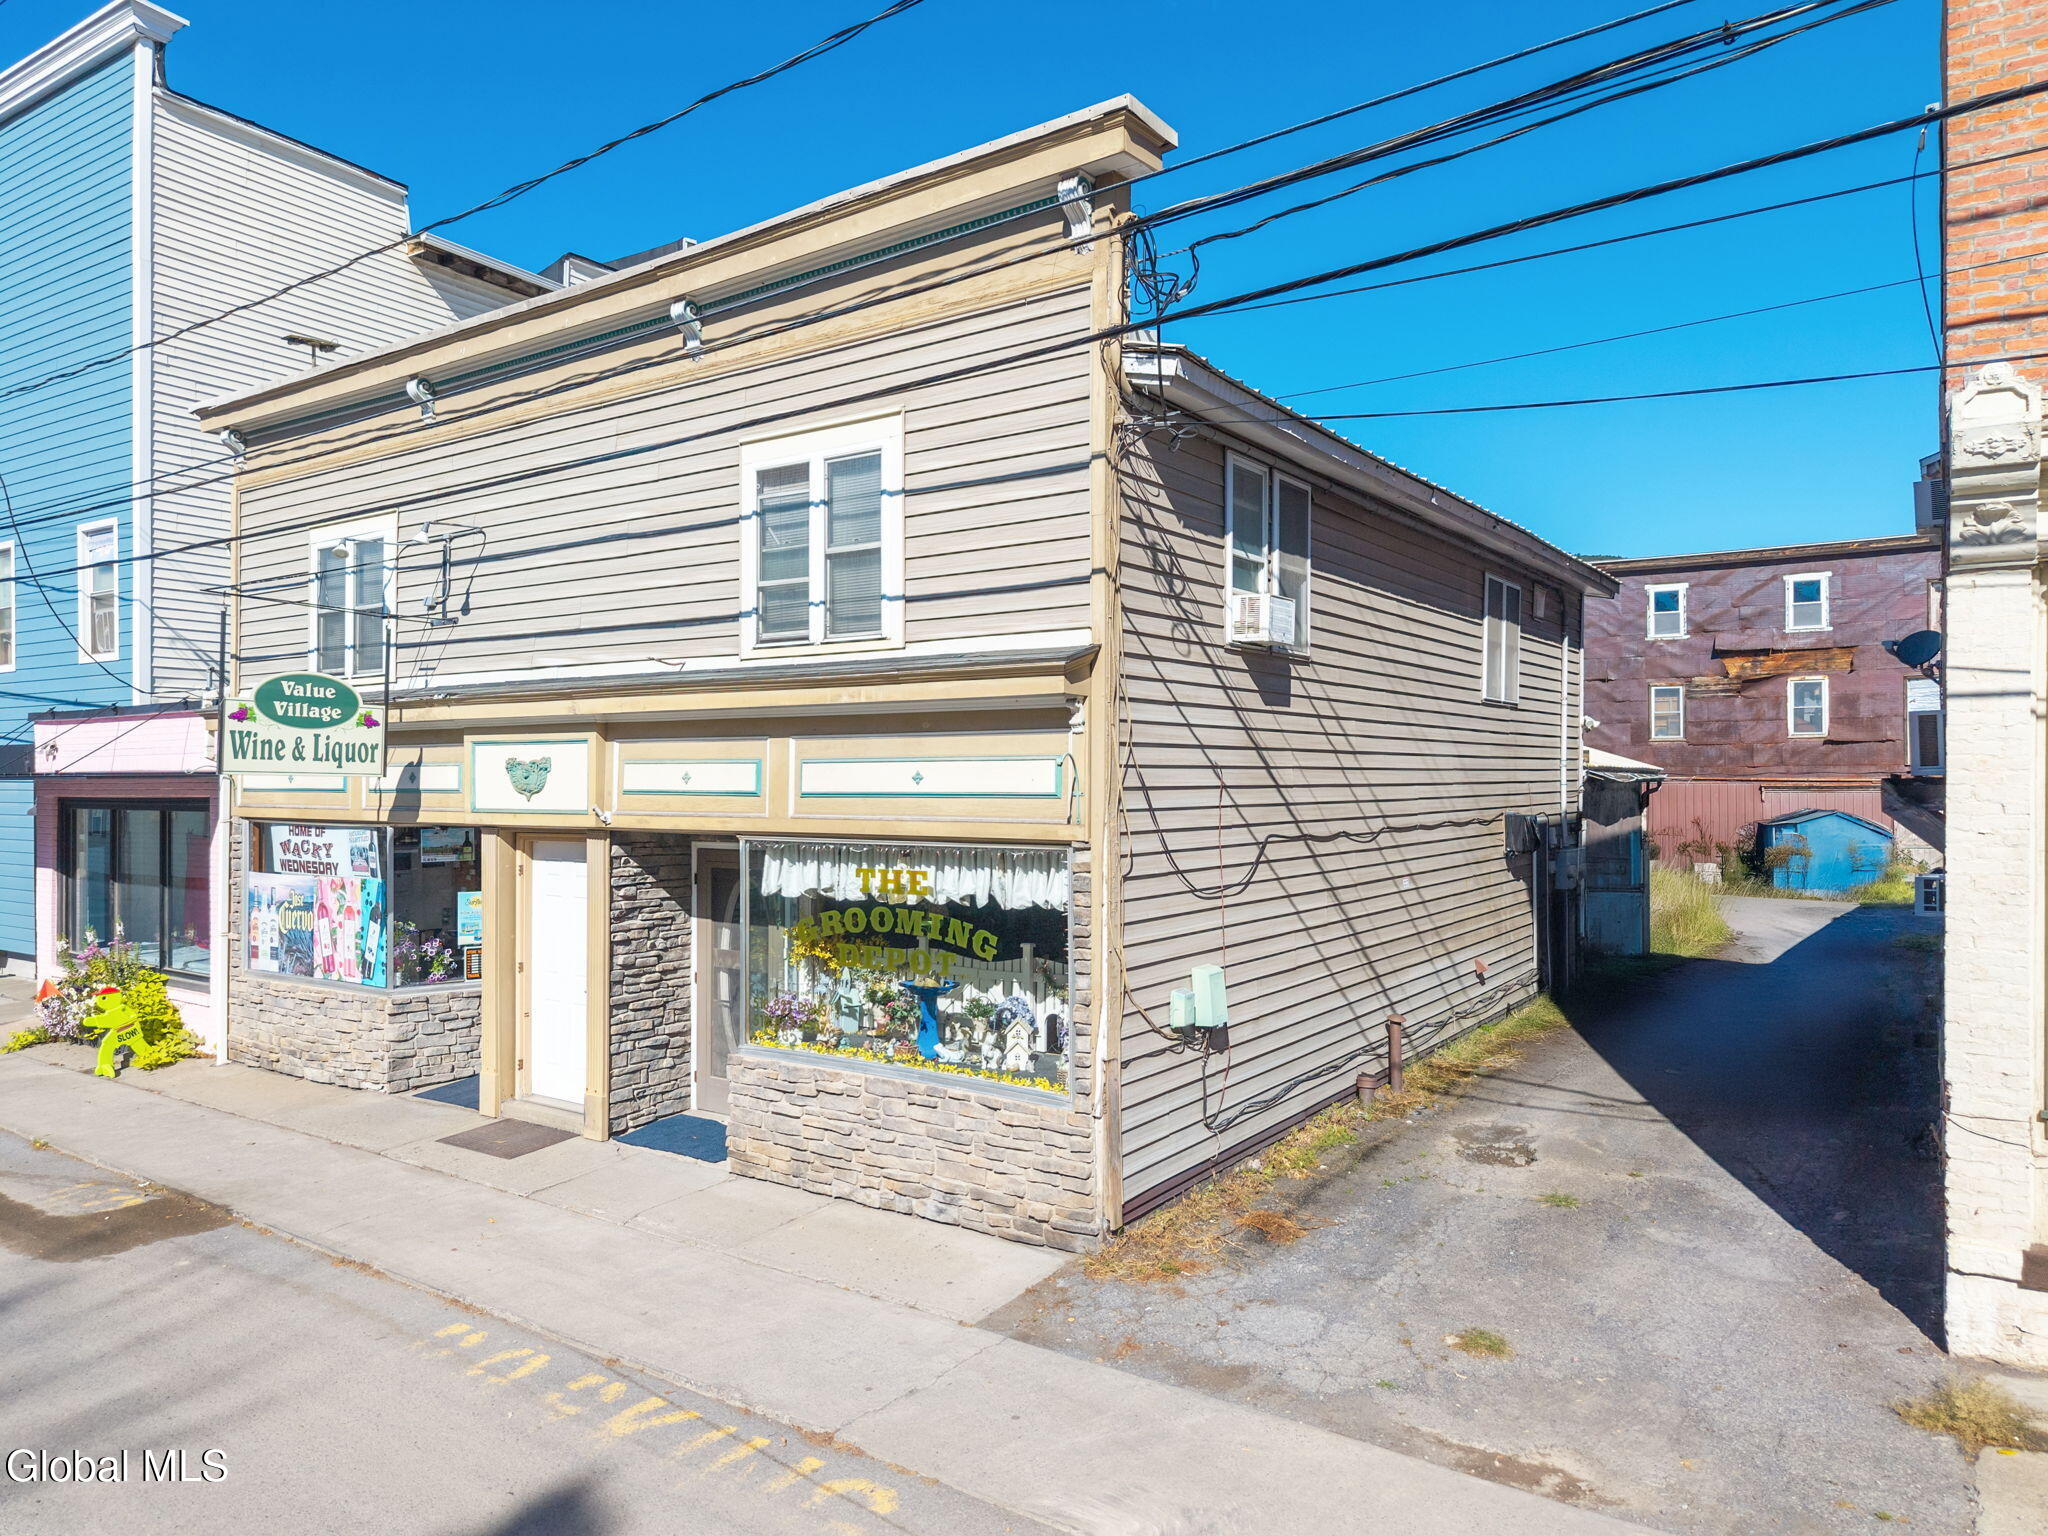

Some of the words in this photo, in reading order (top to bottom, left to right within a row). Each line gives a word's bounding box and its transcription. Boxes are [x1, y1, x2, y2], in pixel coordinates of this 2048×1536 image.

[280, 680, 337, 698] Value
[273, 701, 342, 722] Village
[229, 729, 286, 761] Wine
[291, 736, 306, 761] &
[312, 733, 379, 769] Liquor
[288, 825, 312, 836] HOME
[314, 827, 326, 838] OF
[279, 839, 334, 860] WACKY
[279, 859, 339, 876] WEDNESDAY
[855, 868, 929, 896] THE
[279, 901, 314, 934] Cuervo
[796, 905, 999, 962] GROOMING
[836, 943, 958, 977] DEPOT
[117, 1028, 140, 1043] SLOW!
